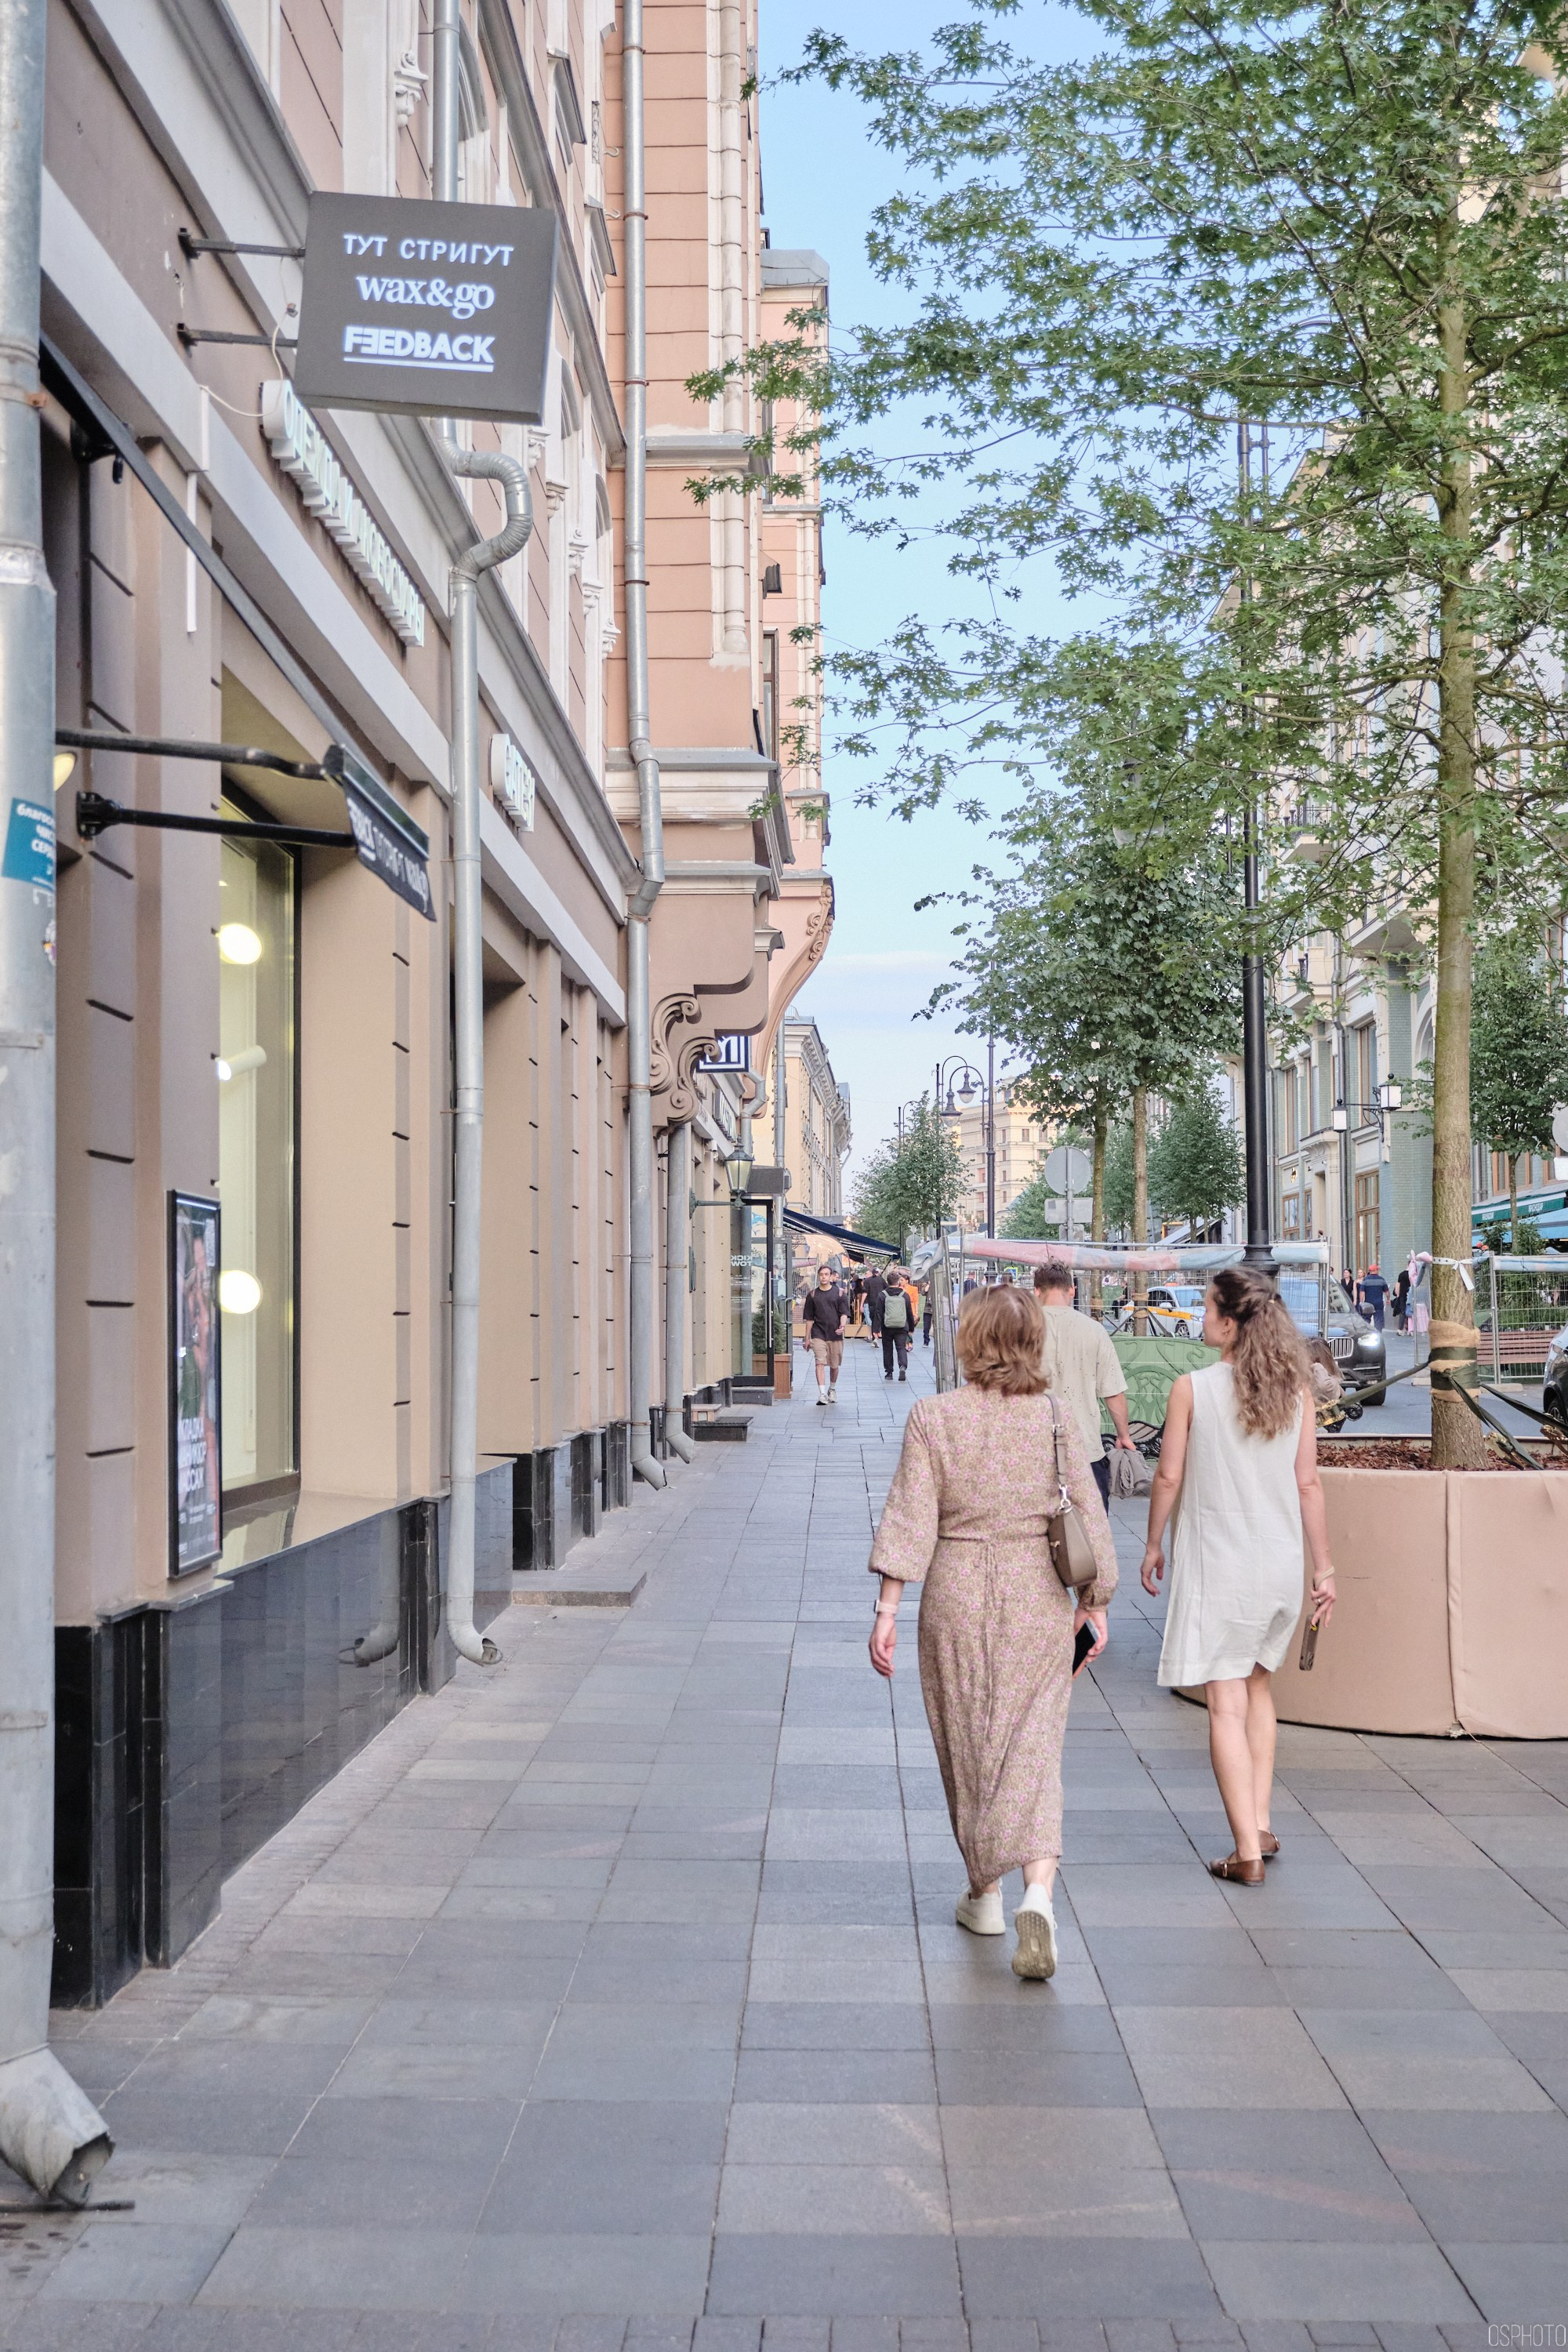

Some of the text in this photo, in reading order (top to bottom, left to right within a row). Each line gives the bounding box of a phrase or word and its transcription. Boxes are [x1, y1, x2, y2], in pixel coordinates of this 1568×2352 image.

[343, 234, 514, 267] ТУТ СТРИГУТ
[356, 276, 495, 319] wax&go
[343, 325, 496, 363] FEEDBACK
[270, 380, 340, 518] ОДЕЖДА
